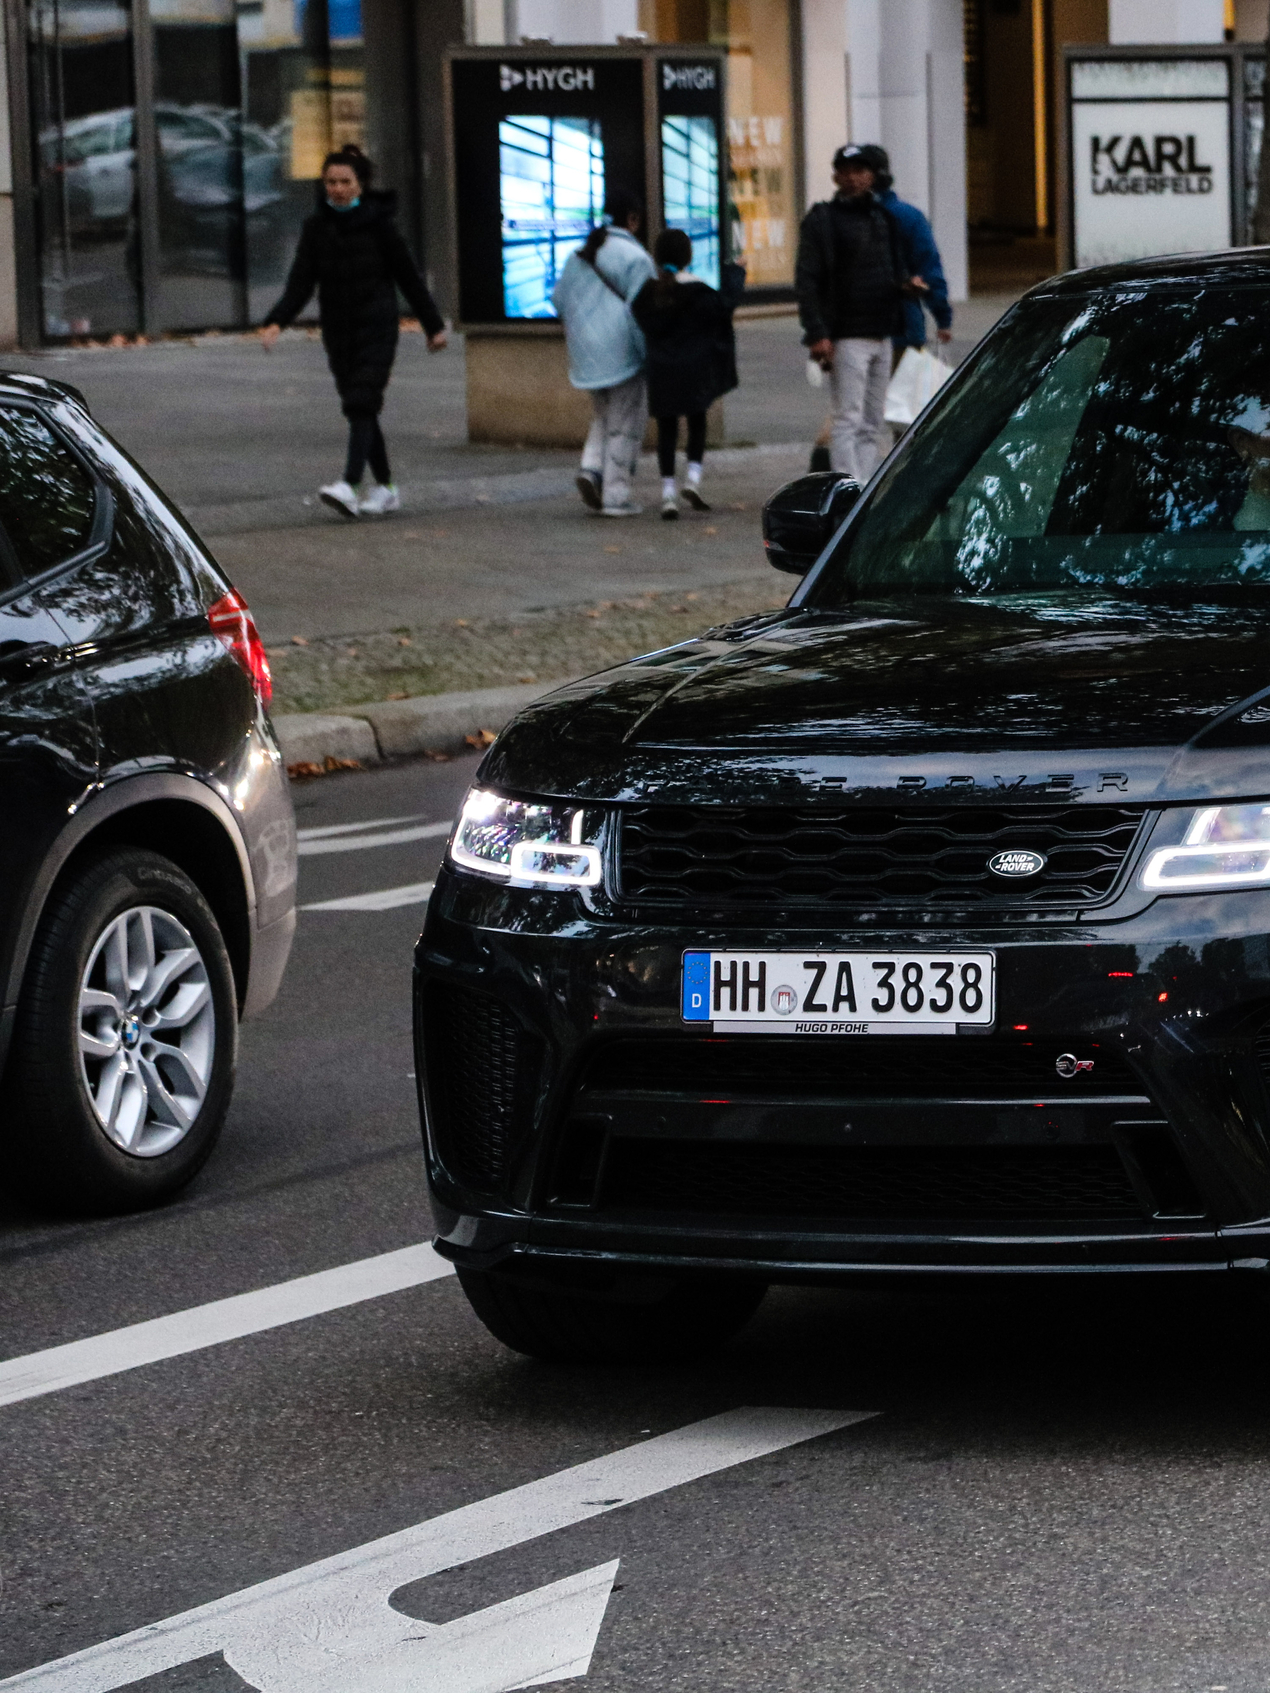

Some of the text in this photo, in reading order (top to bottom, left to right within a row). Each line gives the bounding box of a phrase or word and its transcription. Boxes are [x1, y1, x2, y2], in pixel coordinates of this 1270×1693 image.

[525, 66, 595, 91] HYGH
[676, 66, 716, 91] HYGH
[728, 116, 784, 147] NEW
[1090, 134, 1212, 174] KARL
[1091, 175, 1213, 195] LAGERFELD
[731, 220, 786, 250] NEW
[896, 773, 1129, 793] ROVER
[999, 854, 1028, 862] LAND
[1000, 863, 1035, 871] ROVER
[713, 960, 983, 1013] HH ZA 3838
[691, 993, 702, 1008] D
[795, 1023, 869, 1033] HUGO PFOHE
